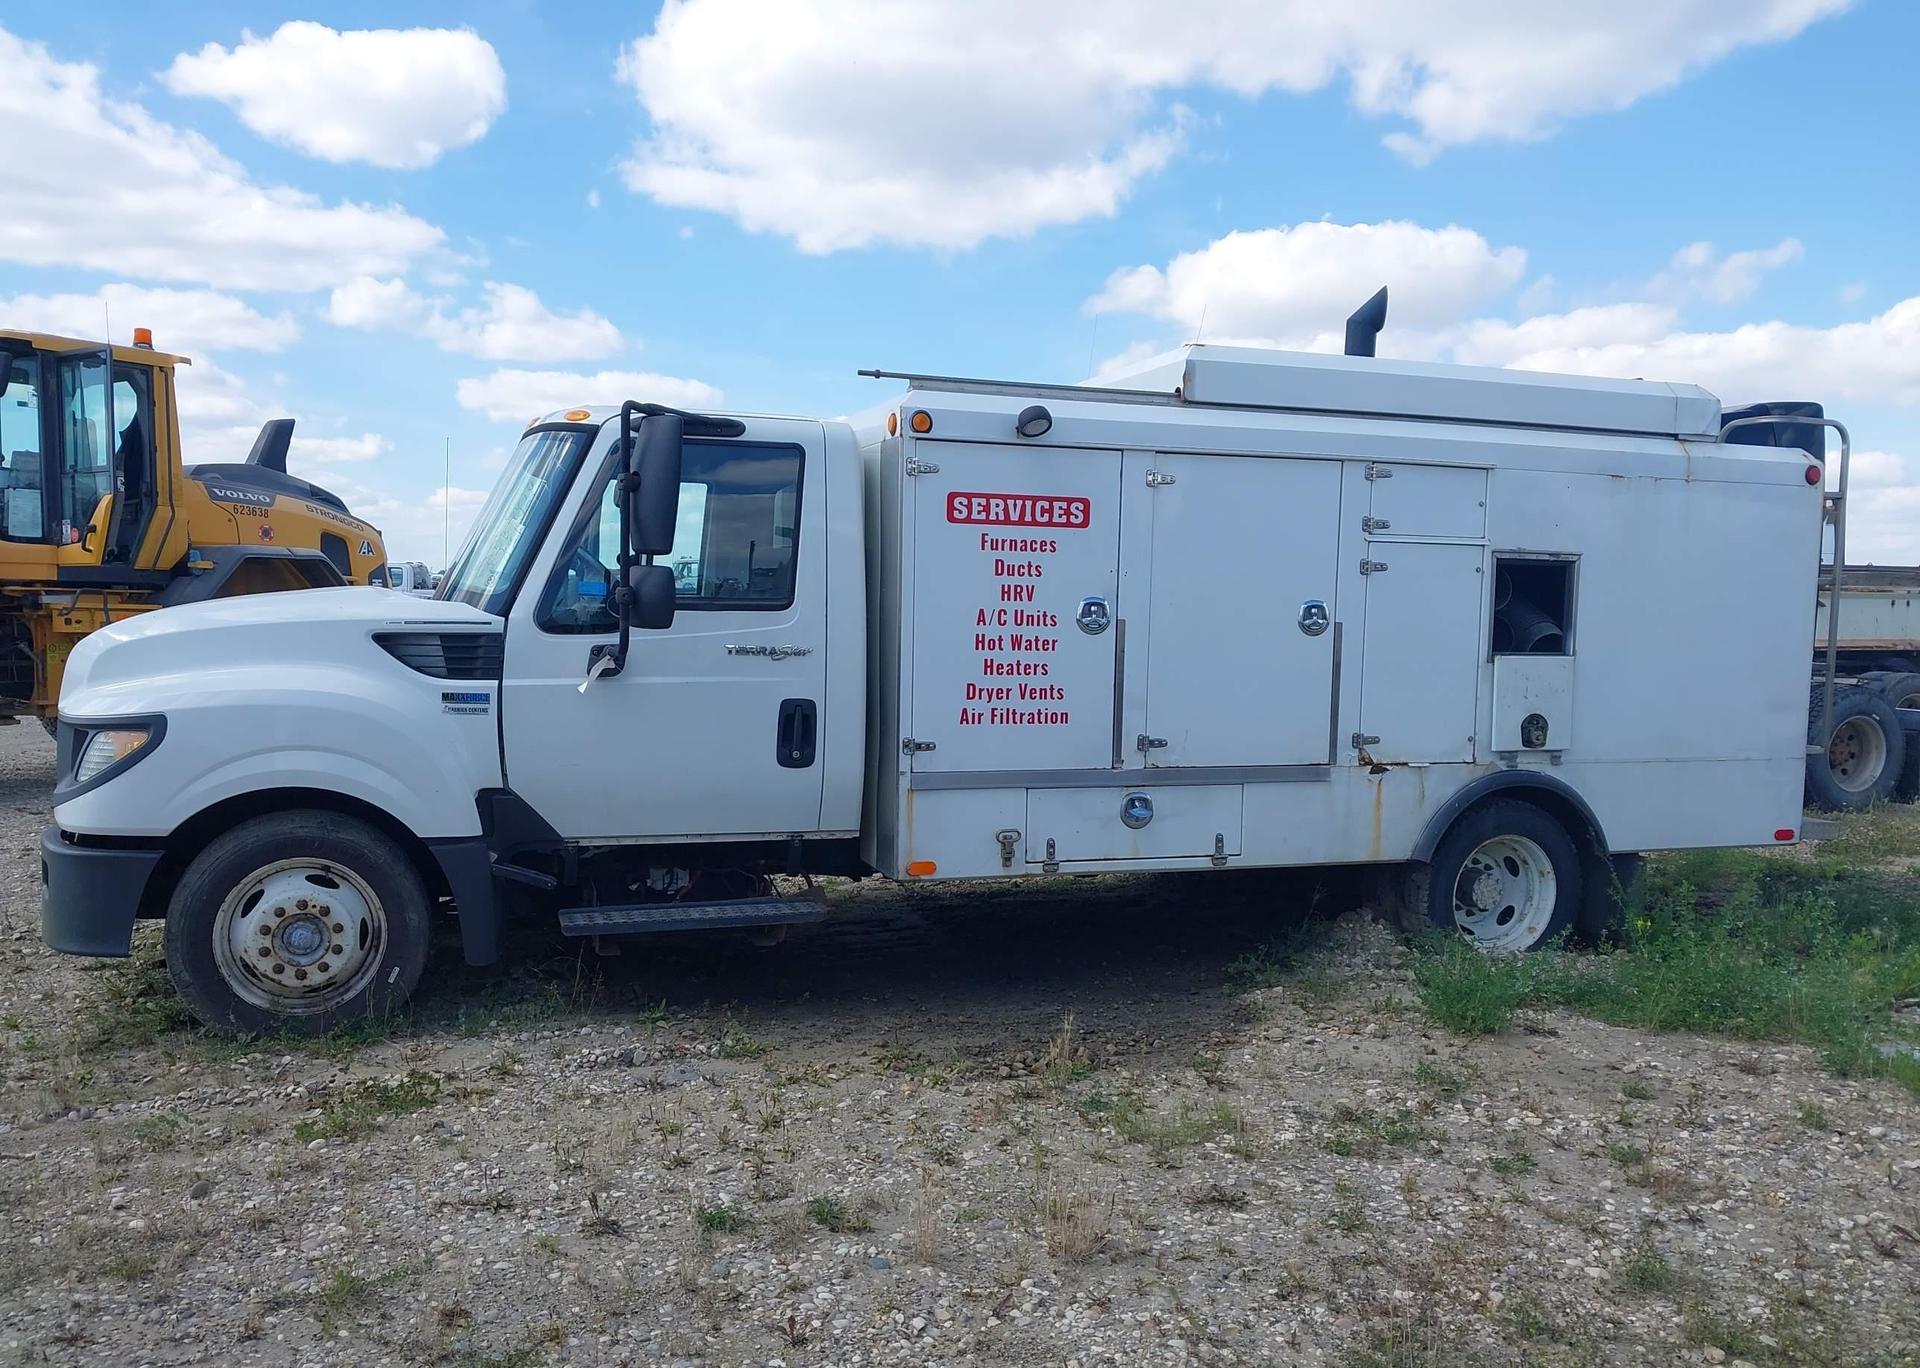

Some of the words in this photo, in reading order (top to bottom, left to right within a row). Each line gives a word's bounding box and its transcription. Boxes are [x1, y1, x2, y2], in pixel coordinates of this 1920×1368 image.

[213, 488, 271, 503] VOLVO
[232, 504, 269, 519] 623638
[304, 504, 365, 532] STRONGCO
[952, 496, 1085, 525] SERVICES
[980, 532, 1057, 553] Furnaces
[994, 558, 1043, 577] Ducts
[1001, 584, 1035, 602] HRV
[976, 608, 1007, 627] A/C
[1014, 609, 1058, 627] Units
[975, 633, 1004, 651] Hot
[1010, 634, 1058, 651] Water
[983, 658, 1049, 676] Heaters
[966, 682, 1012, 703] Dryer
[1018, 683, 1064, 701] Vents
[959, 707, 984, 725] Air
[990, 707, 1069, 725] Filtration
